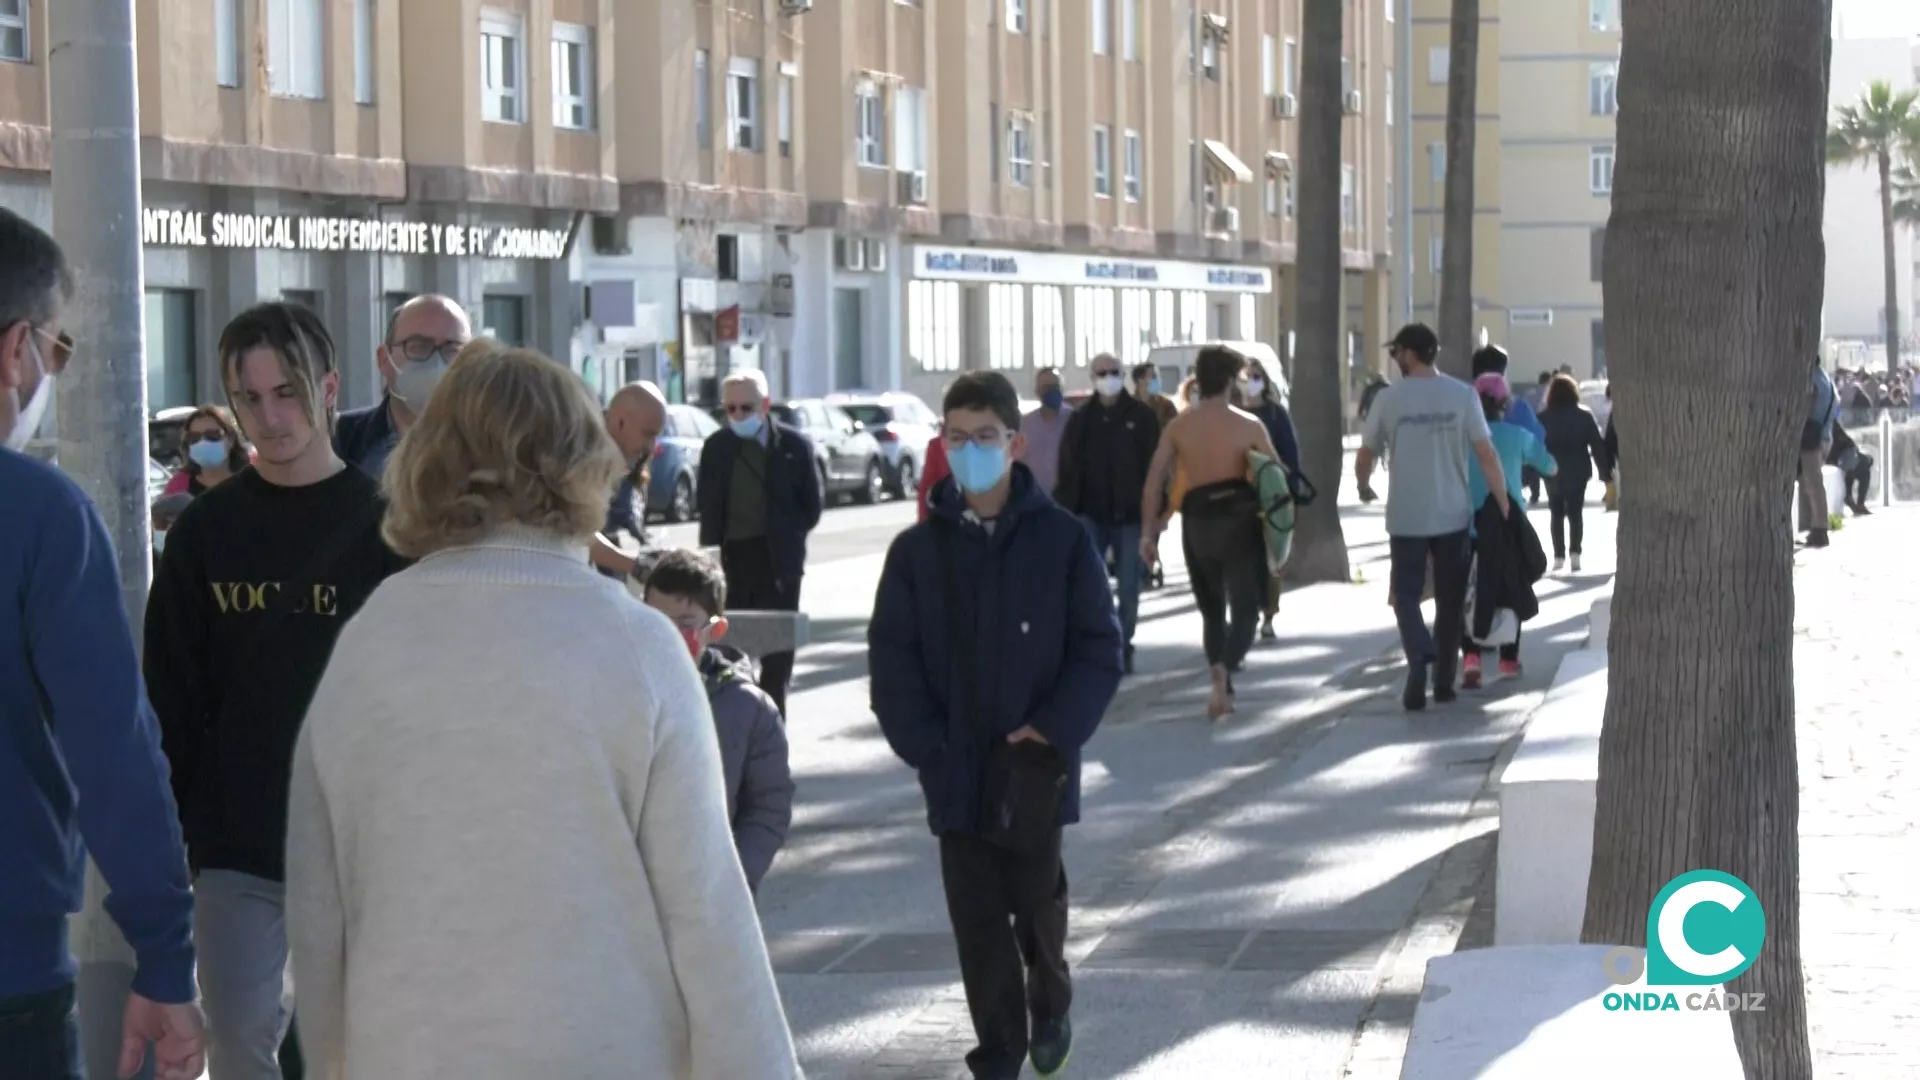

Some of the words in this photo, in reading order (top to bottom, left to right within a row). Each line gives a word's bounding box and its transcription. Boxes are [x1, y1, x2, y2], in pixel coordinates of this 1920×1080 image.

[212, 212, 295, 249] SINDICAL
[299, 216, 428, 253] INDEPENDIENTE
[431, 224, 442, 254] Y
[446, 224, 466, 255] DE
